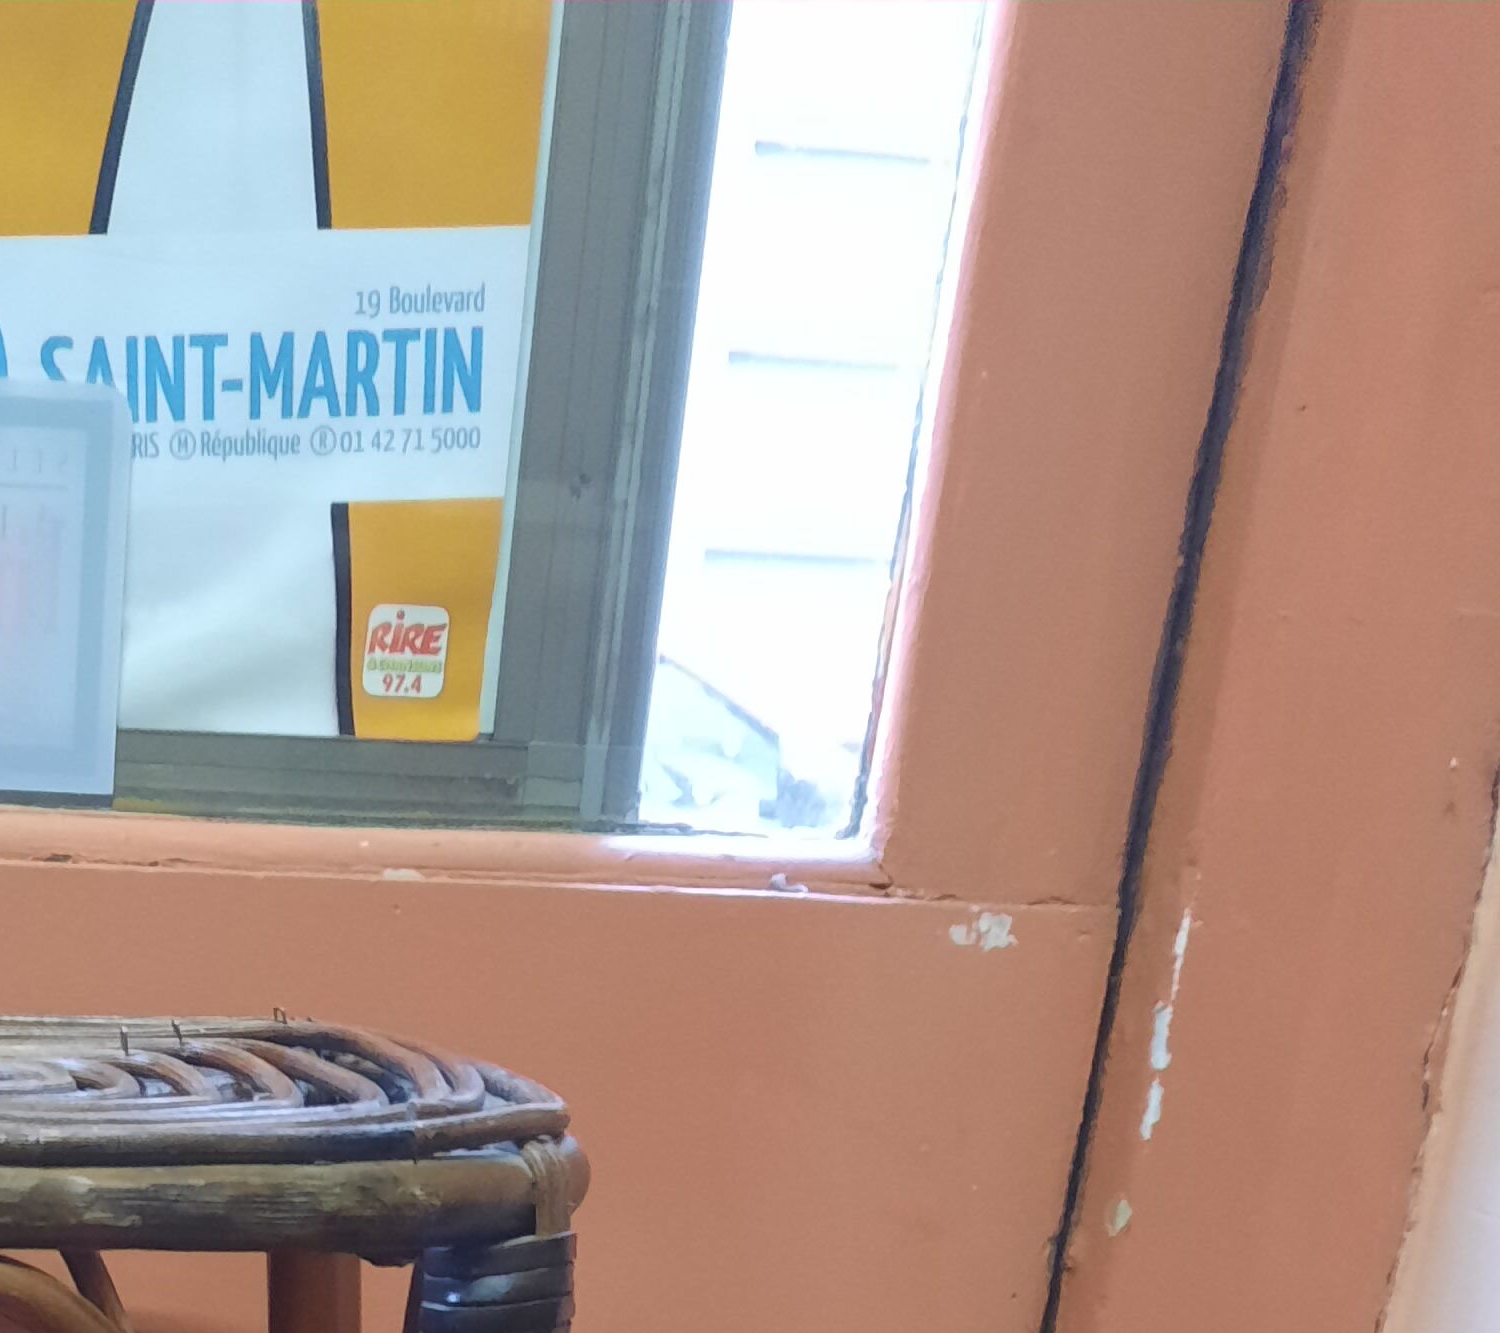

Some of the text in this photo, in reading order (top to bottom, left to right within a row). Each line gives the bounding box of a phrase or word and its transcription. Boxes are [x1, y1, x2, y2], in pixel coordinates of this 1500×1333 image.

[355, 283, 486, 318] 19 Boulevard
[132, 431, 160, 460] RIS
[200, 428, 300, 463] République
[340, 430, 364, 454] 01
[371, 429, 396, 453] 42
[401, 428, 423, 455] 71
[431, 427, 481, 453] 5000
[382, 673, 422, 695] 97.4
